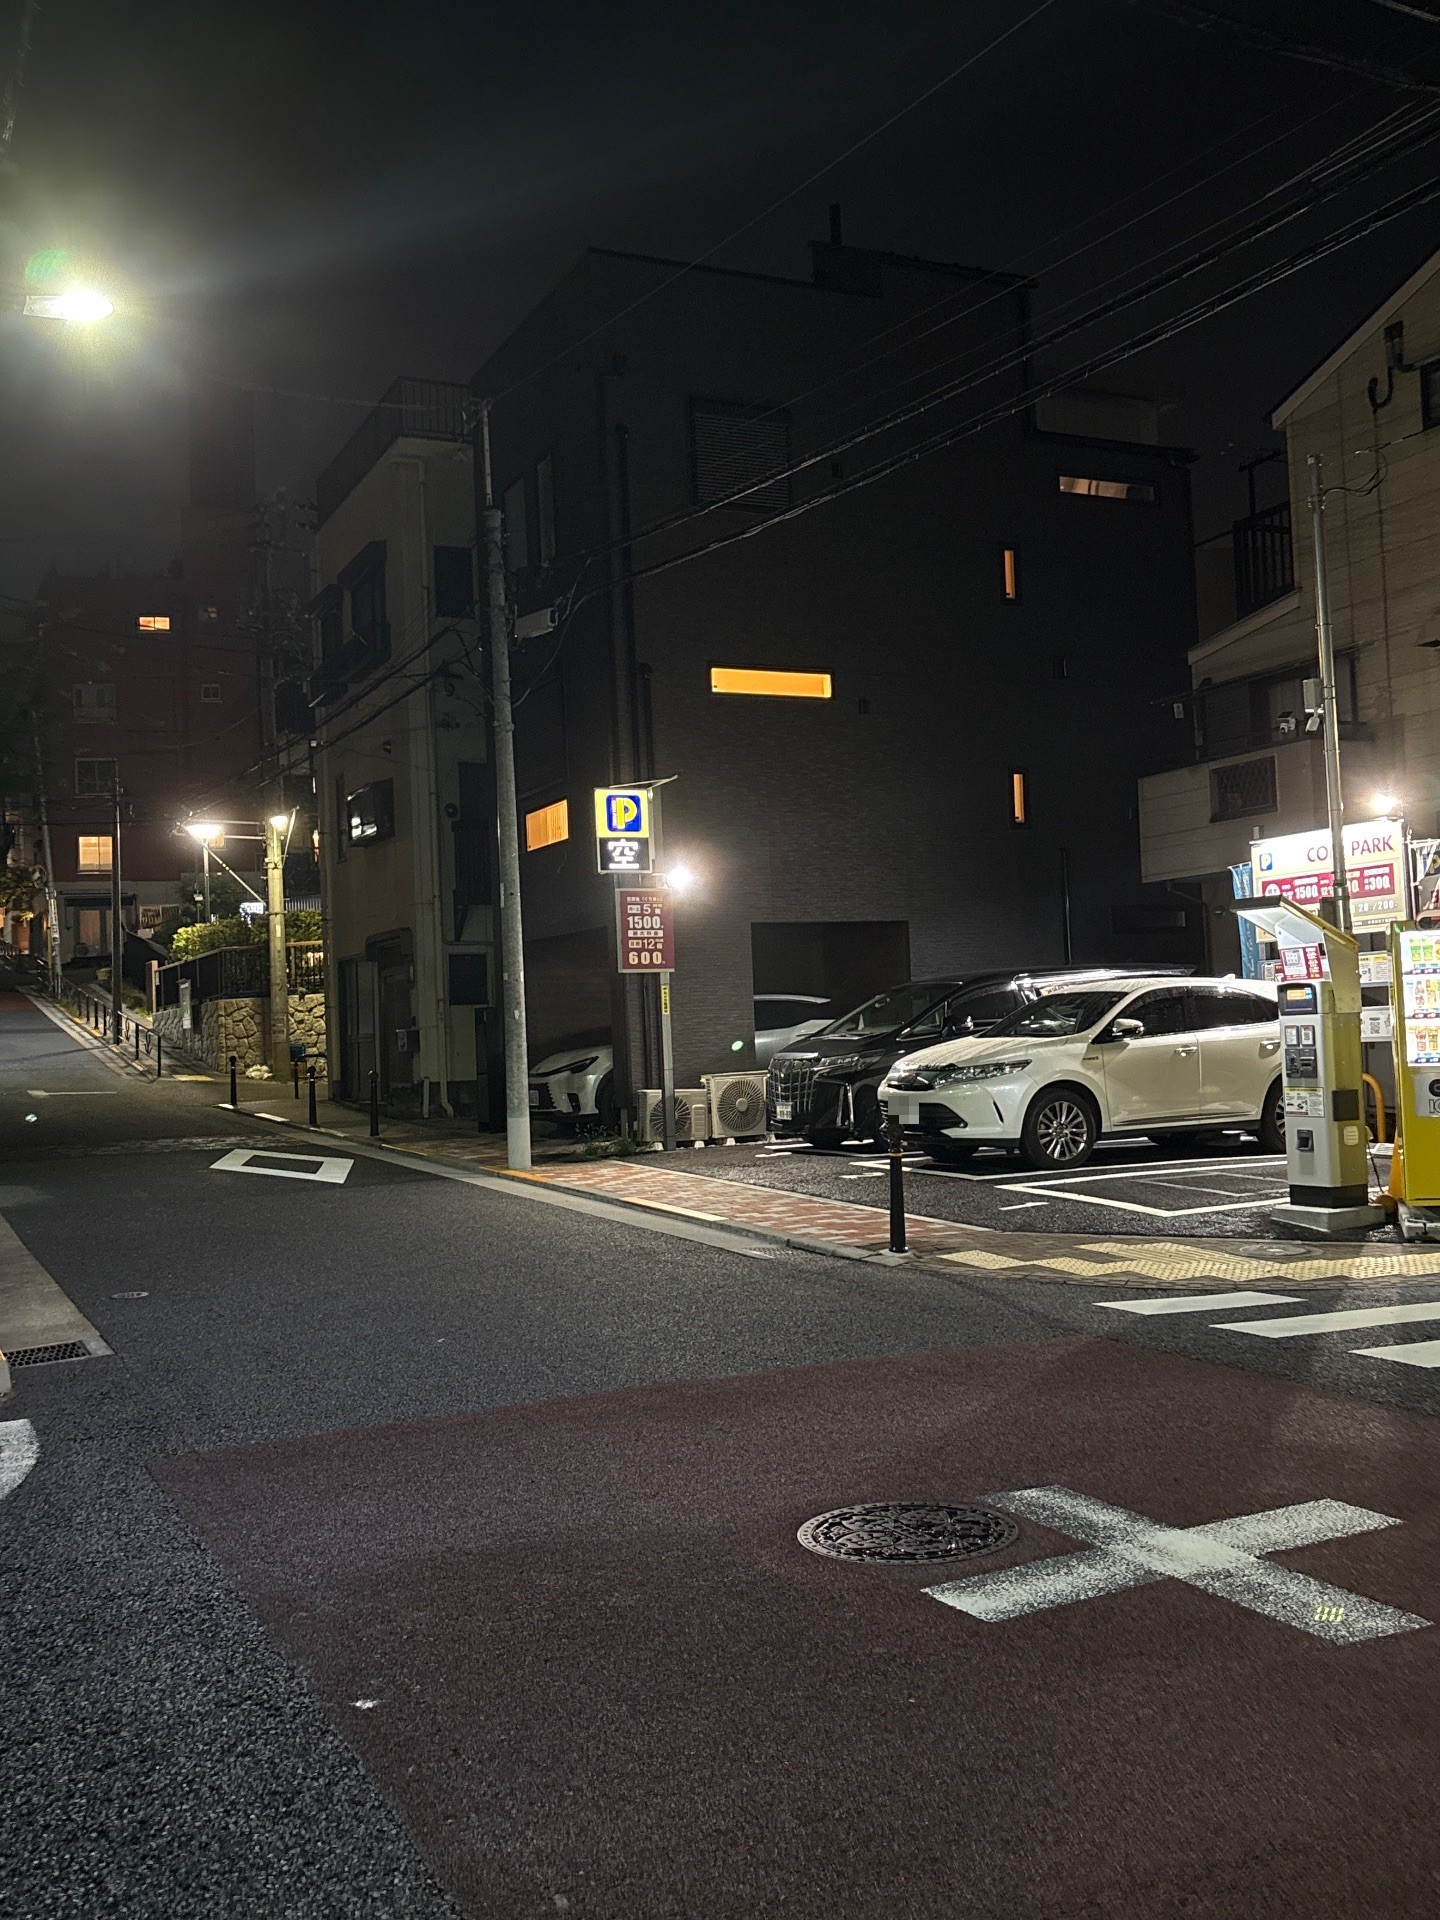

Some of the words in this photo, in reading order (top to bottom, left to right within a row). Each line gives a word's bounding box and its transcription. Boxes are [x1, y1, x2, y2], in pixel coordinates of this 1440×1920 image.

[607, 838, 640, 870] 空
[1306, 844, 1333, 863] COI
[1351, 834, 1394, 857] PARK
[1294, 884, 1318, 899] 1500
[643, 903, 651, 915] 5
[627, 915, 661, 929] 1500
[643, 938, 655, 950] 12
[628, 951, 662, 965] 600
